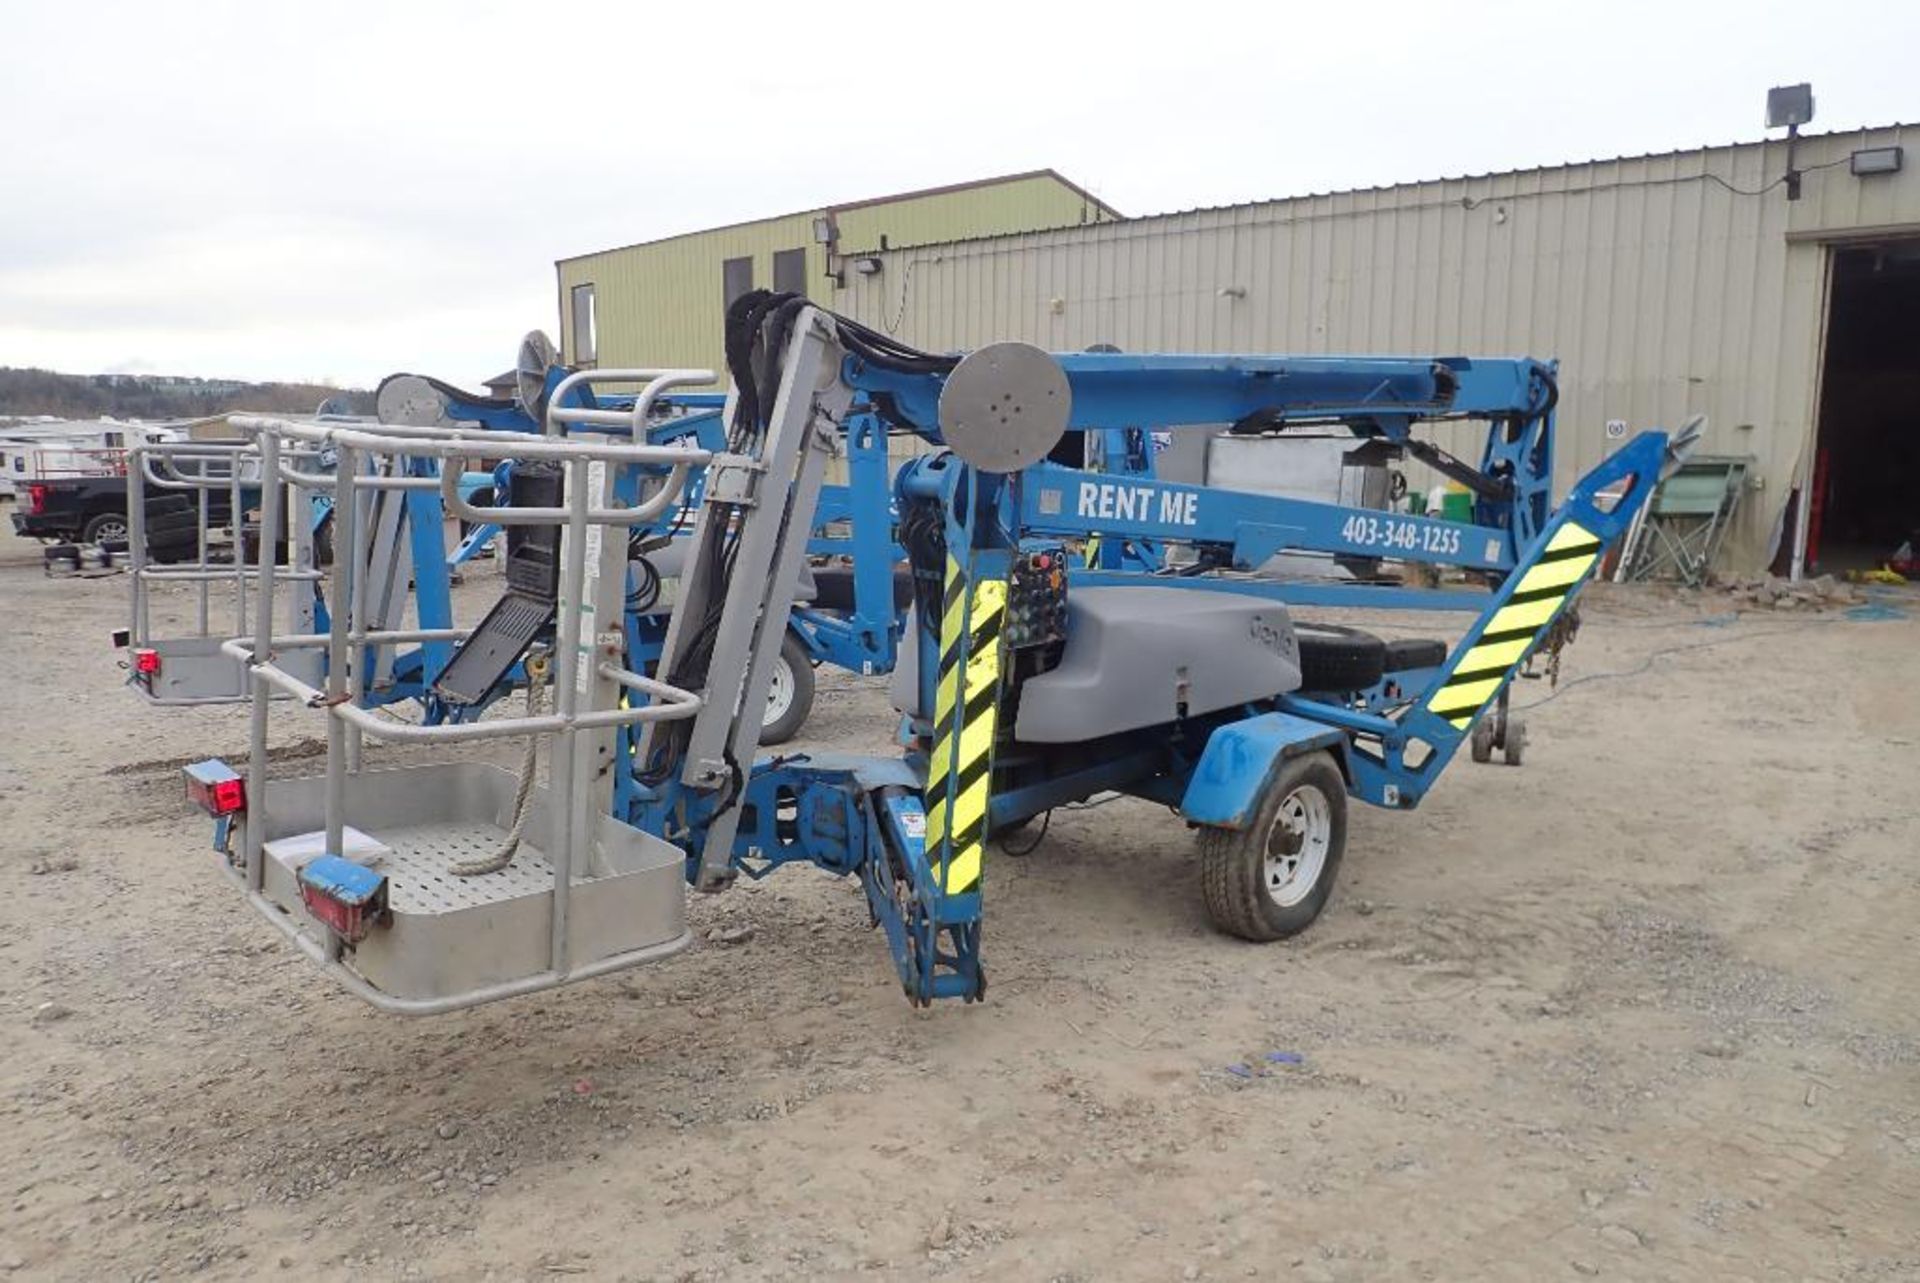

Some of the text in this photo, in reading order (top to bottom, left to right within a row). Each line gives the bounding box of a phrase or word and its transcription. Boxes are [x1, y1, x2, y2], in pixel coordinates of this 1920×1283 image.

[1078, 482, 1198, 525] RENT ME
[1342, 515, 1461, 554] 403-348-1255
